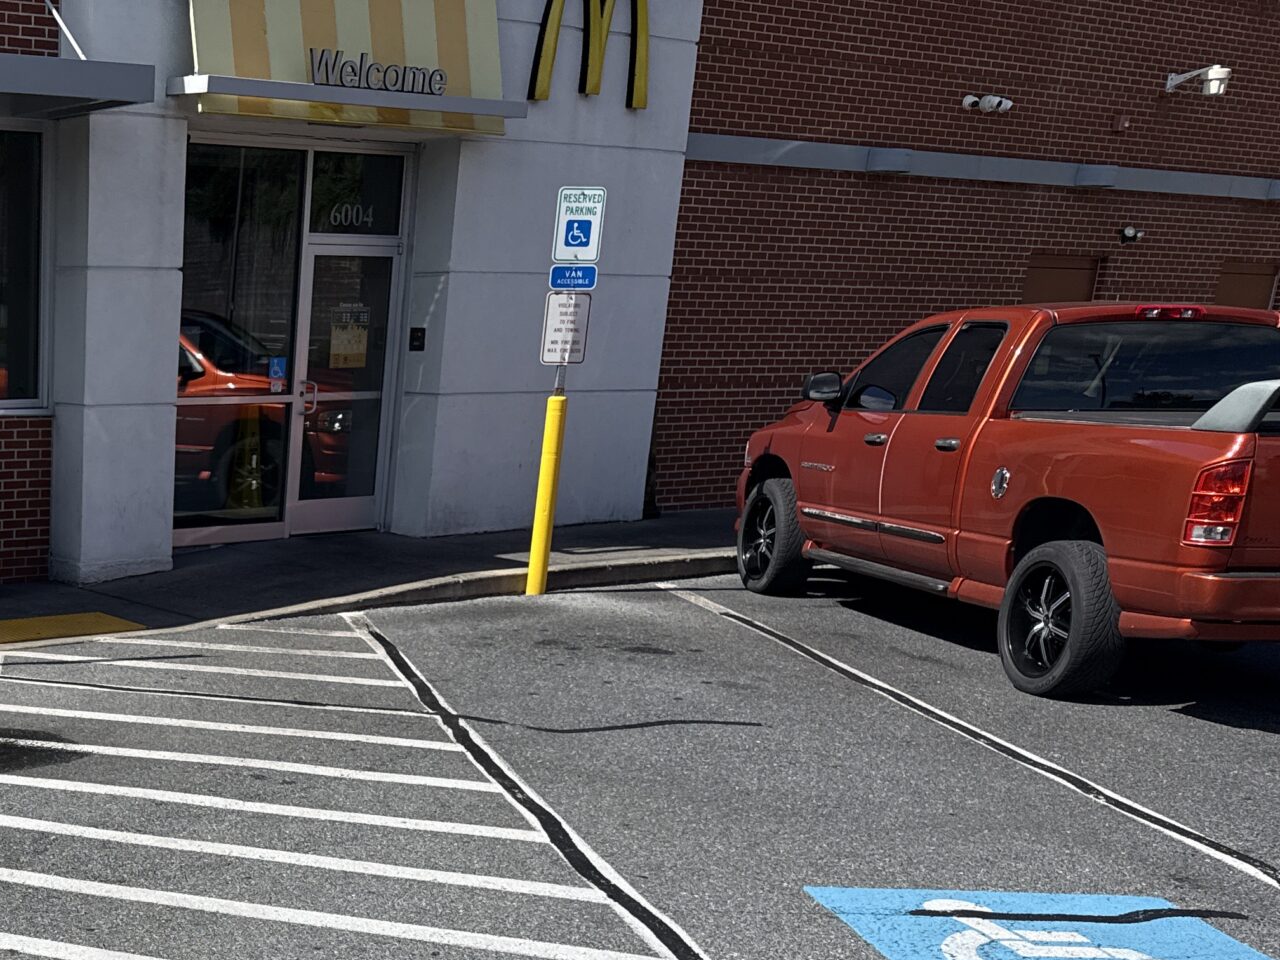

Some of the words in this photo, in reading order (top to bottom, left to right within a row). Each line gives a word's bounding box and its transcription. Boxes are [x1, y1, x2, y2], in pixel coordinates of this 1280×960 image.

[309, 47, 448, 96] Welcome
[563, 193, 603, 204] RESERVED
[330, 203, 374, 228] 6004
[565, 206, 597, 216] PARKING
[565, 270, 583, 278] VAN
